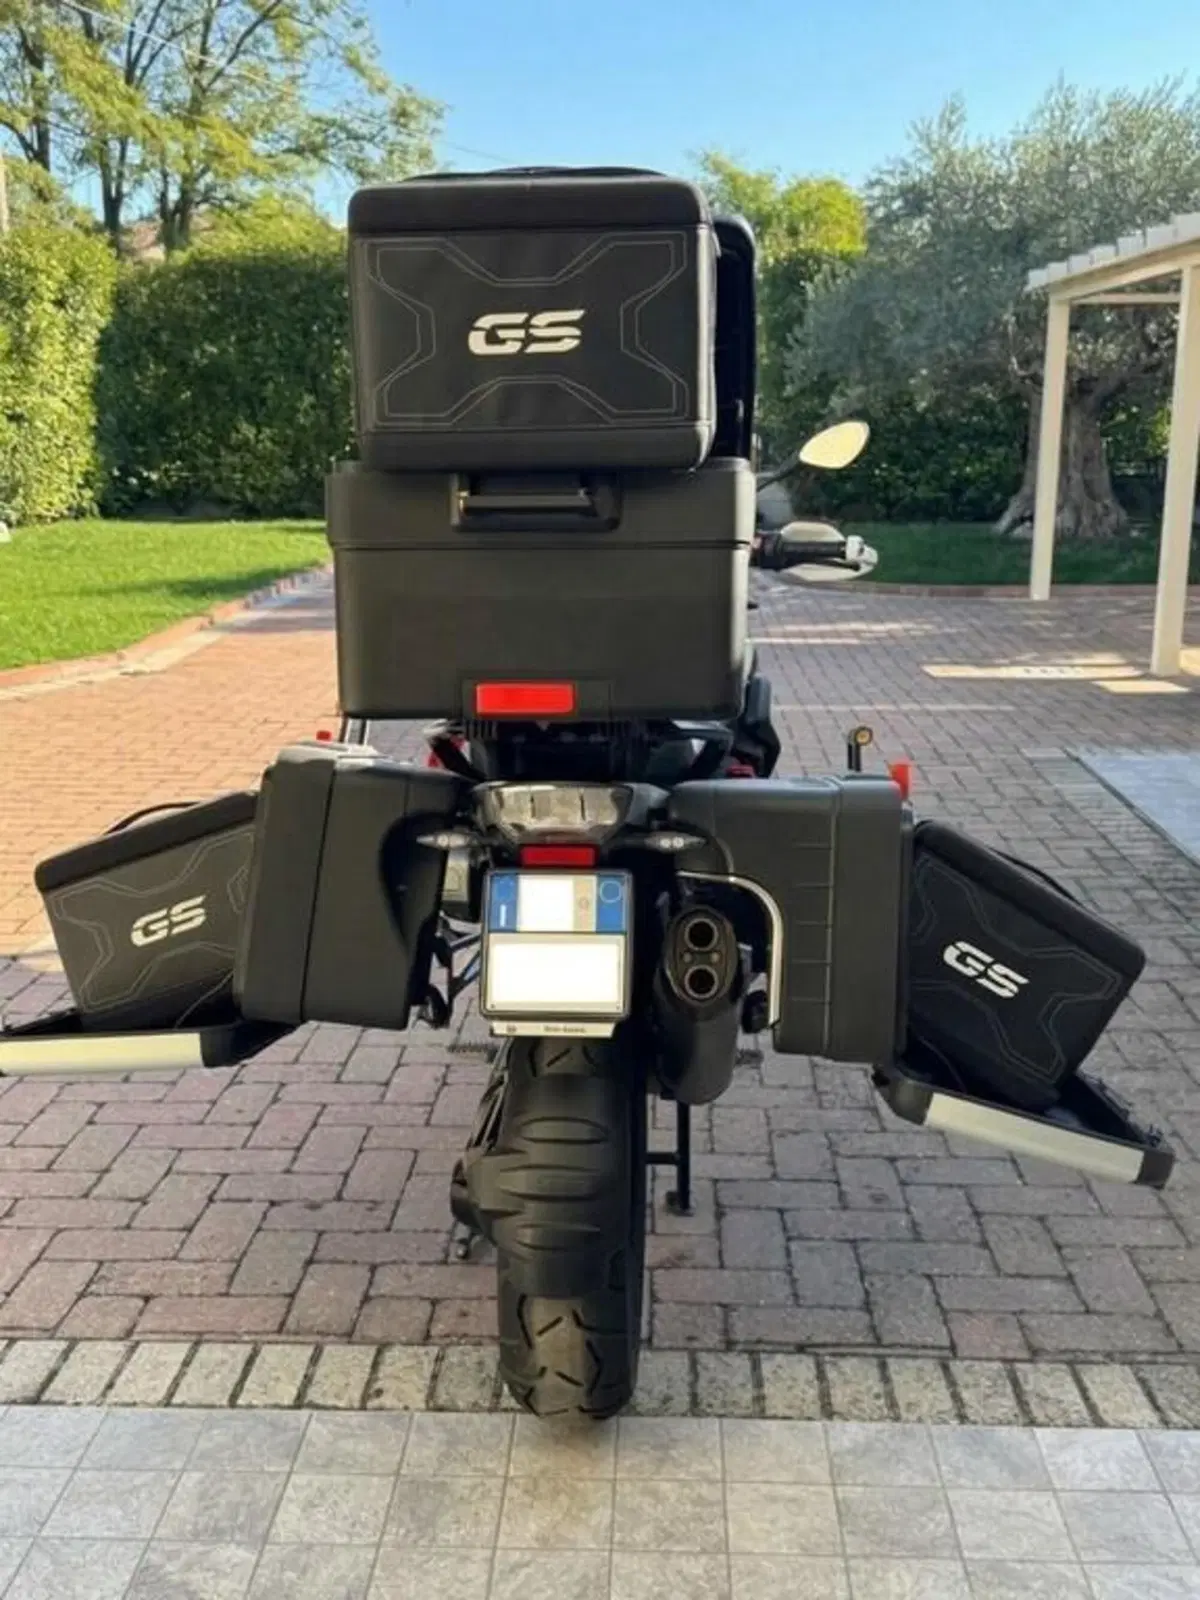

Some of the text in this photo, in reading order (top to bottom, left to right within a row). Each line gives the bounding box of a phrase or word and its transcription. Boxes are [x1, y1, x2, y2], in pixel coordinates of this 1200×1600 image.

[467, 309, 585, 355] GS
[130, 894, 207, 947] GS
[943, 940, 1030, 998] GS
